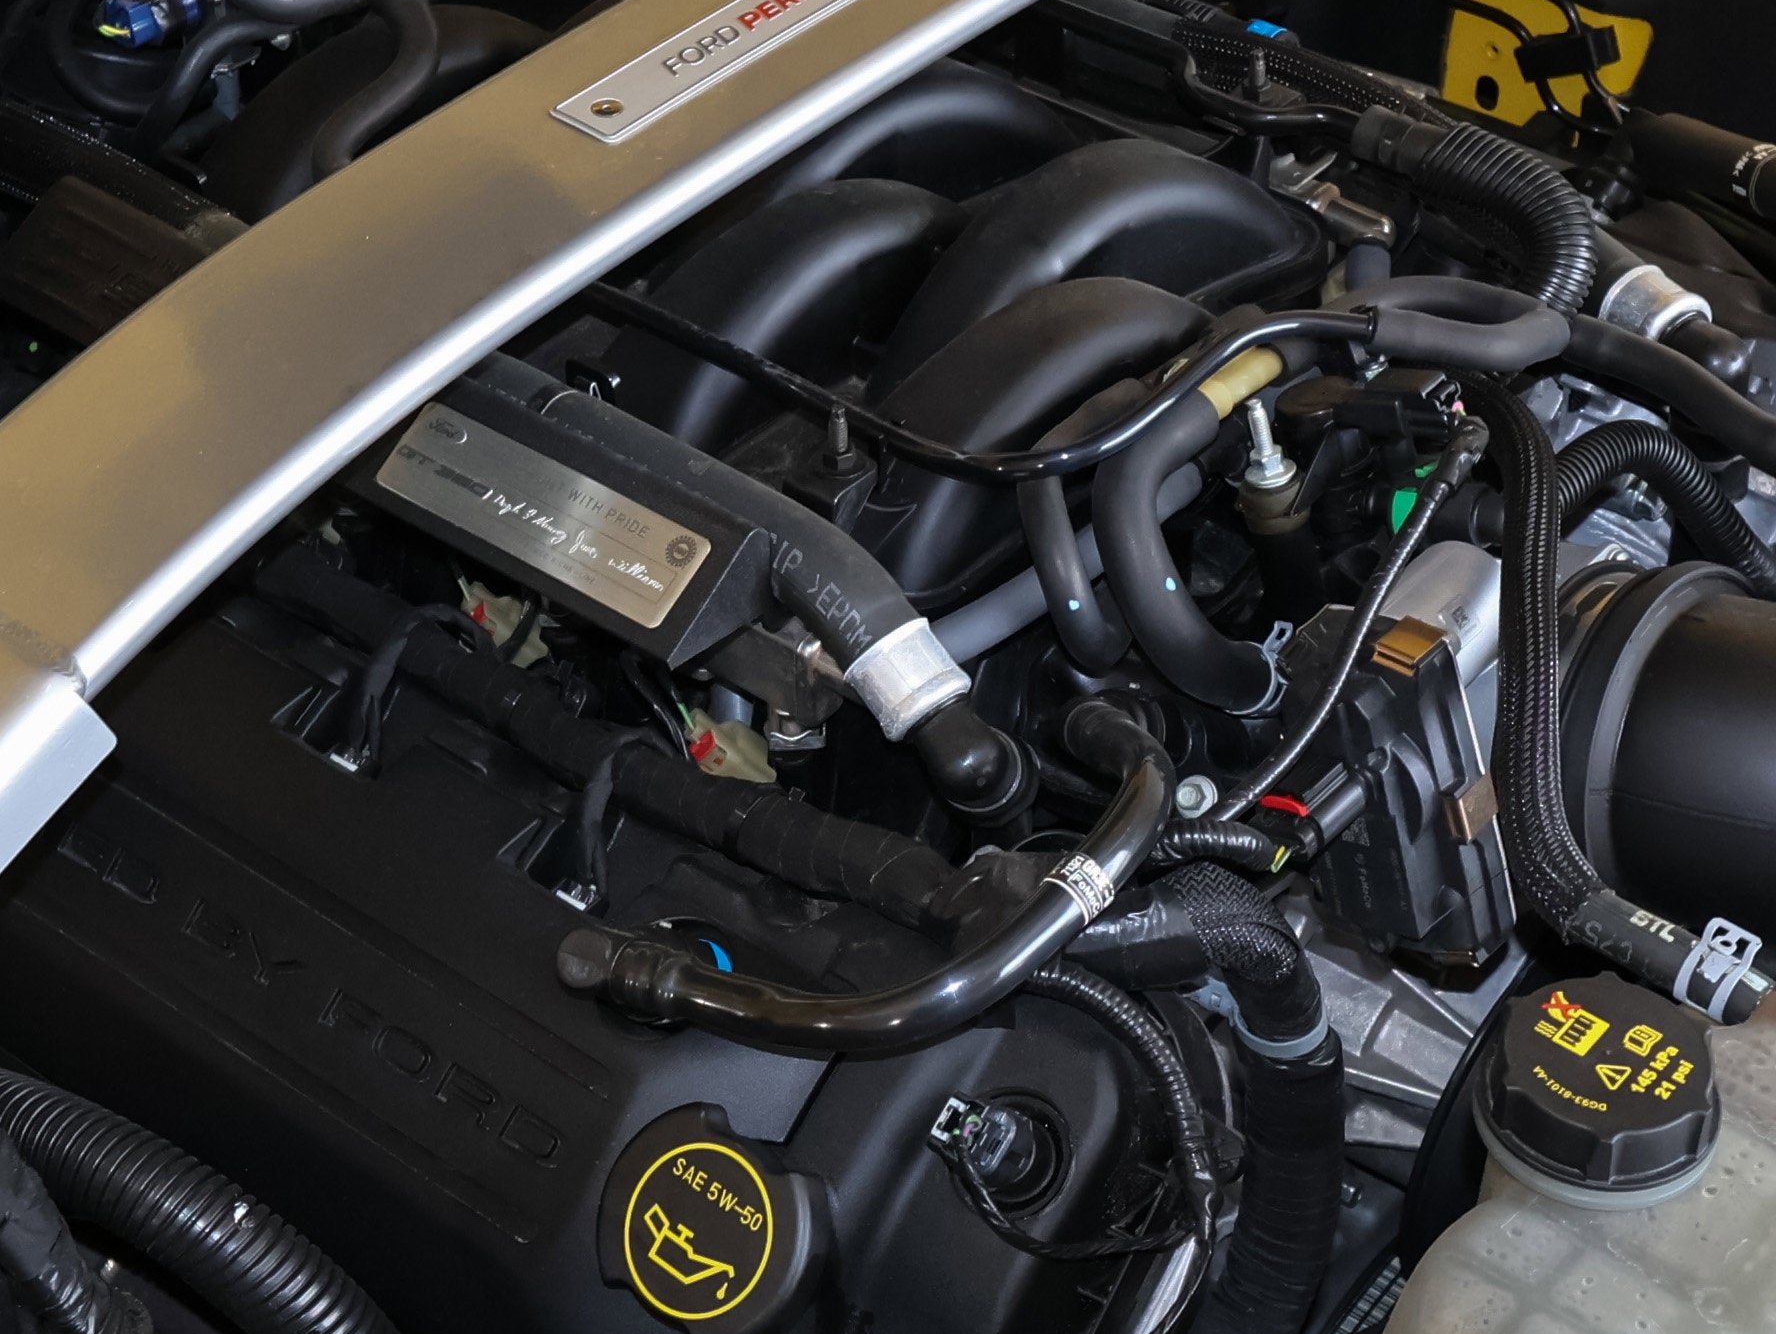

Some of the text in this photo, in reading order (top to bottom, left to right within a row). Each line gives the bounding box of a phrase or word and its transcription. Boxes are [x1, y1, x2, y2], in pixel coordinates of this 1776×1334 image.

[662, 25, 741, 77] FORD
[568, 486, 604, 514] WITH
[603, 507, 651, 539] PRIDE
[1071, 873, 1100, 918] FoMoC
[319, 987, 562, 1169] FORD
[1630, 1045, 1680, 1094] 145 kPa
[1654, 1059, 1695, 1101] 21 psi
[672, 1158, 764, 1232] SAE 5W-50
